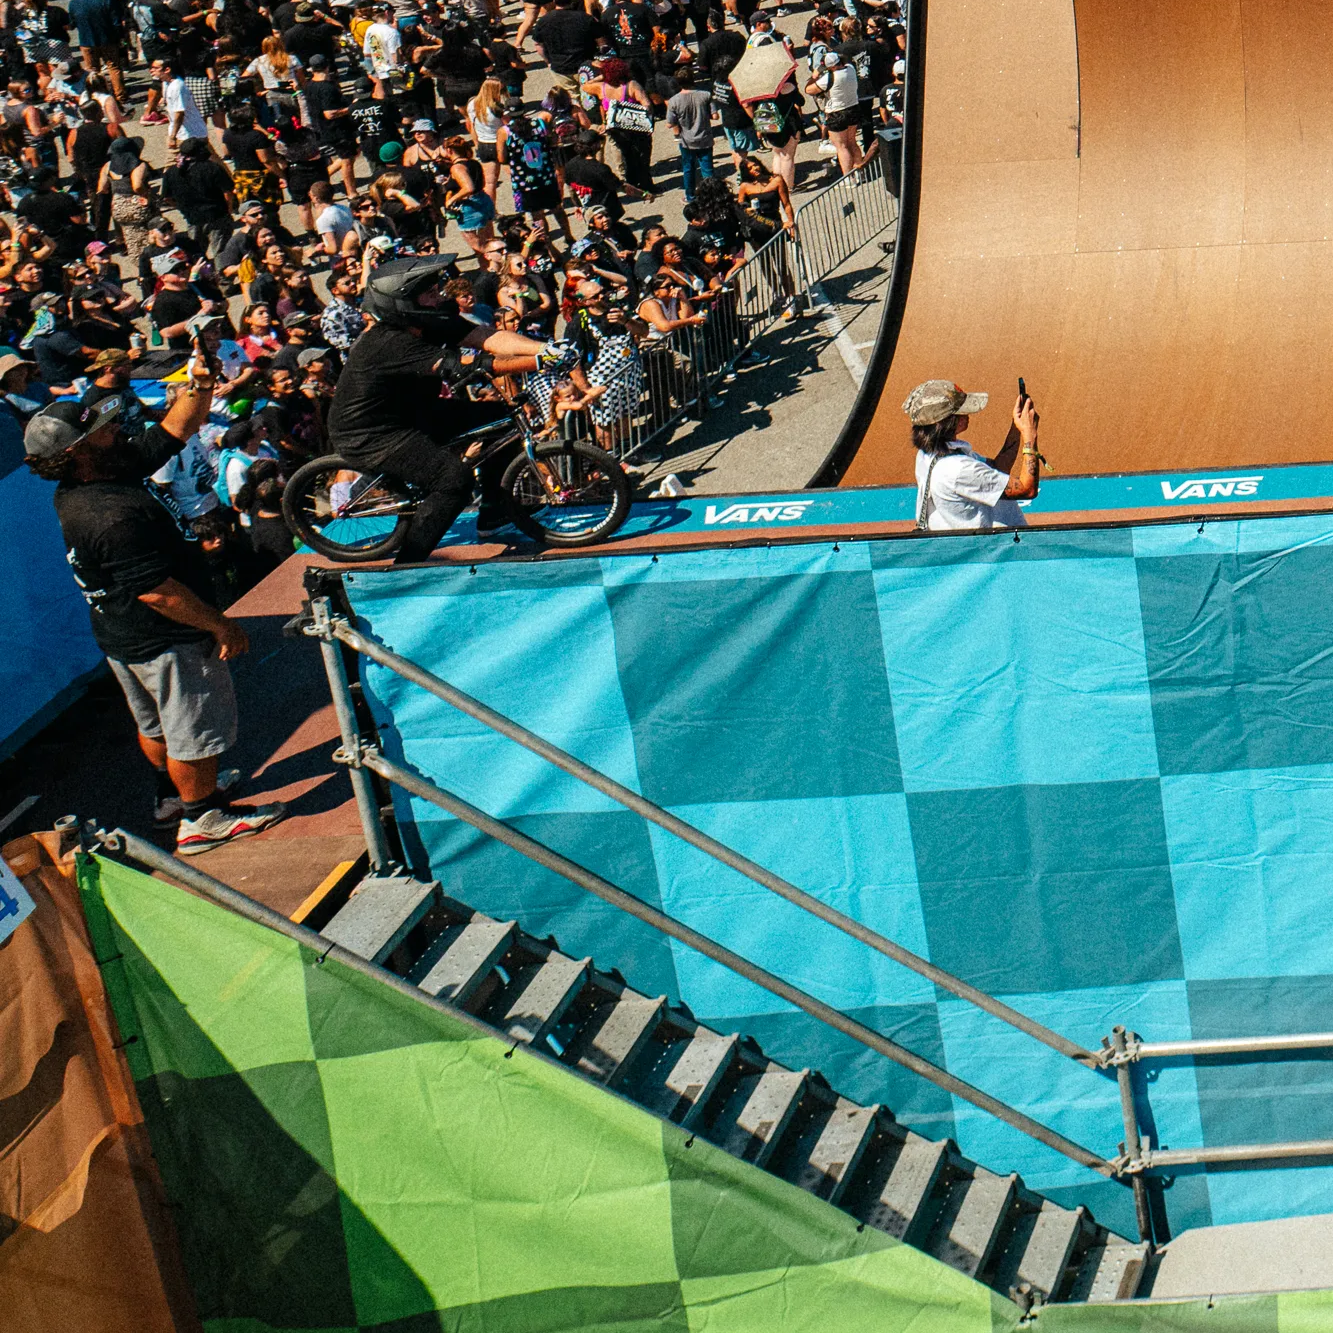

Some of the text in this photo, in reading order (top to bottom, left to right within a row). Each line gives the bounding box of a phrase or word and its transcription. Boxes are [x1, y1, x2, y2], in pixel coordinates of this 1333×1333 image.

[615, 107, 647, 122] VANS
[704, 500, 814, 525] VANS
[1161, 476, 1263, 500] VANS
